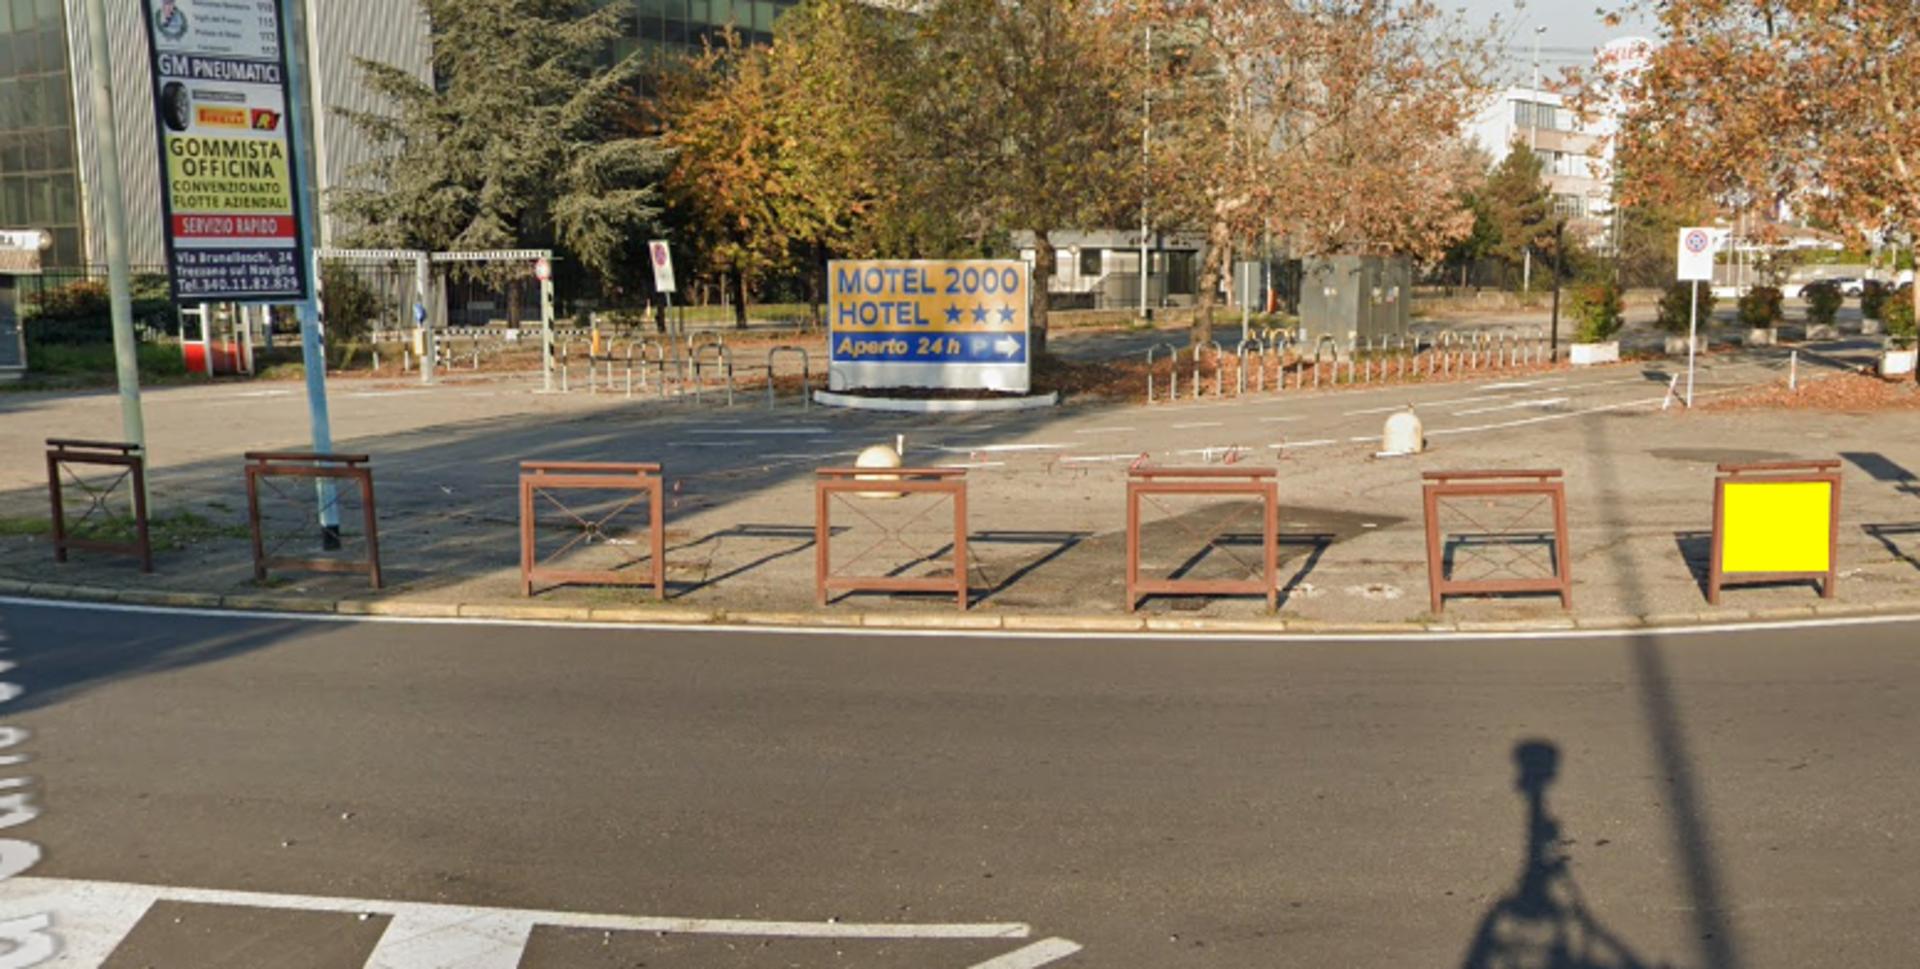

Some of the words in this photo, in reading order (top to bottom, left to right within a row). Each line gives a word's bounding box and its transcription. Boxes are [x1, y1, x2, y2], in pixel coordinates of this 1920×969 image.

[158, 54, 189, 75] GM
[192, 59, 280, 82] PNEUMATICI
[170, 138, 282, 160] GOMMISTA
[182, 158, 276, 178] OFFICINA
[172, 180, 281, 194] CONVENZIONATO
[173, 195, 219, 208] FLOTTE
[224, 197, 288, 209] AZIENDALI
[182, 217, 233, 234] SERVIZIO
[237, 218, 278, 234] RAPIDO
[175, 252, 195, 264] Via
[229, 265, 246, 276] sul
[249, 264, 296, 279] Naviglio
[837, 267, 936, 294] MOTEL
[945, 267, 1019, 294] 2000
[838, 301, 930, 325] HOTEL
[837, 337, 908, 358] Aperto
